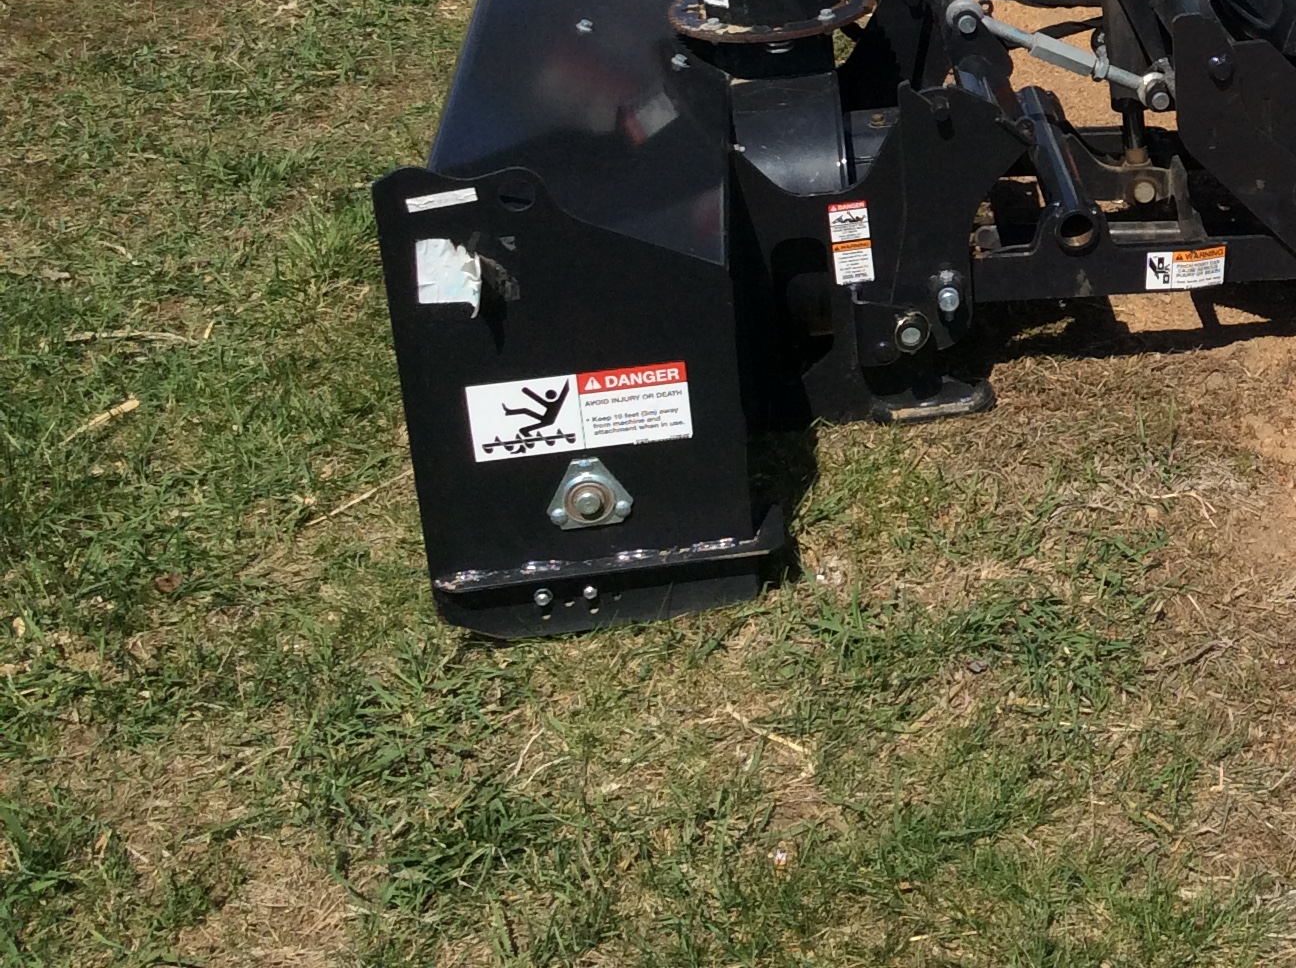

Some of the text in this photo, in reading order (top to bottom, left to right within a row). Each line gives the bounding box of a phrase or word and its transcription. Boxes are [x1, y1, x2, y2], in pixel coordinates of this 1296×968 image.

[1185, 248, 1224, 261] WARNING
[604, 367, 680, 388] DANGER
[584, 398, 610, 407] AVOID
[611, 395, 641, 404] INJURY
[656, 390, 683, 398] DEATH
[591, 415, 612, 423] Keep
[613, 418, 645, 426] machine
[594, 426, 638, 435] attachment
[638, 422, 660, 430] when
